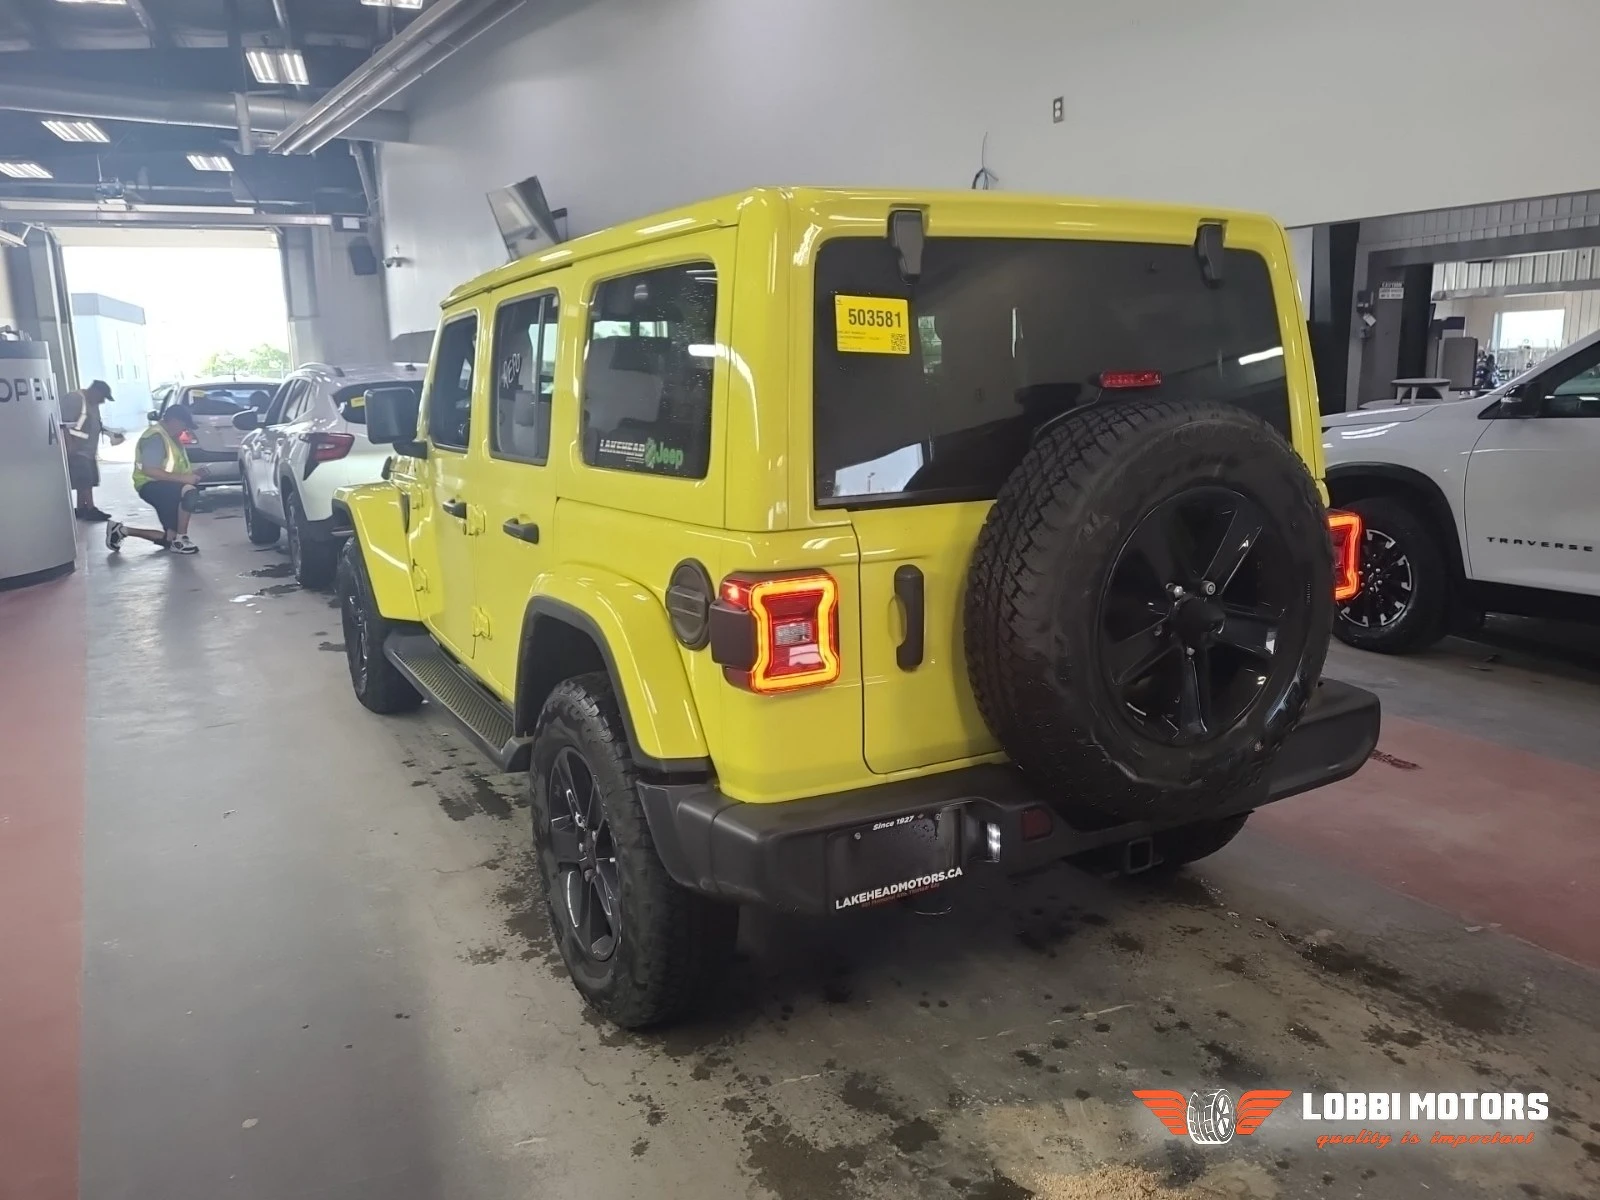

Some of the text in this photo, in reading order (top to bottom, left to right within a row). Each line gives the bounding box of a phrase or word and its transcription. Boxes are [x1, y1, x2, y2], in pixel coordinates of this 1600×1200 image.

[848, 308, 901, 328] 503581
[656, 441, 684, 470] Jeep
[1487, 536, 1593, 552] TRAVERSE
[872, 815, 915, 831] Since 1927
[835, 866, 963, 910] LAKEHEADMOTORS.CA
